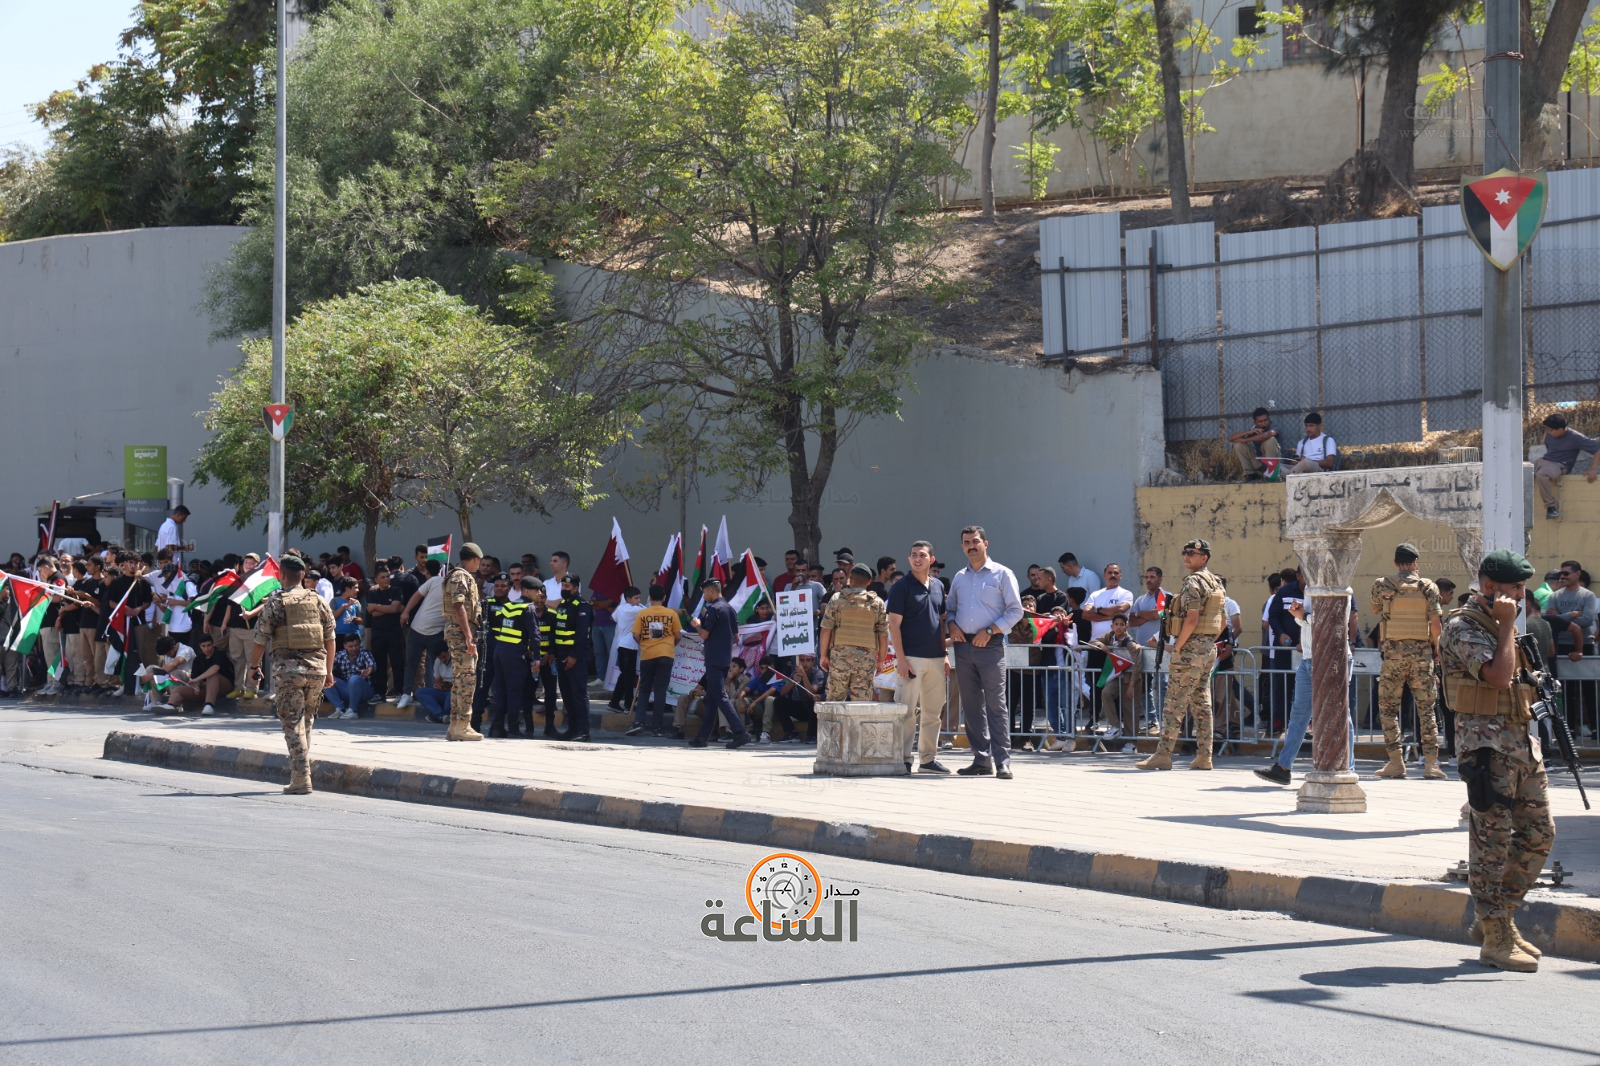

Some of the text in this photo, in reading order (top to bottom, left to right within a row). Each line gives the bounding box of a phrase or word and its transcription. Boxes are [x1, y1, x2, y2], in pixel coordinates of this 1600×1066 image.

[779, 607, 789, 617] الله
[641, 615, 673, 623] NORTH
[797, 620, 809, 628] سمو
[781, 628, 810, 651] تميم
